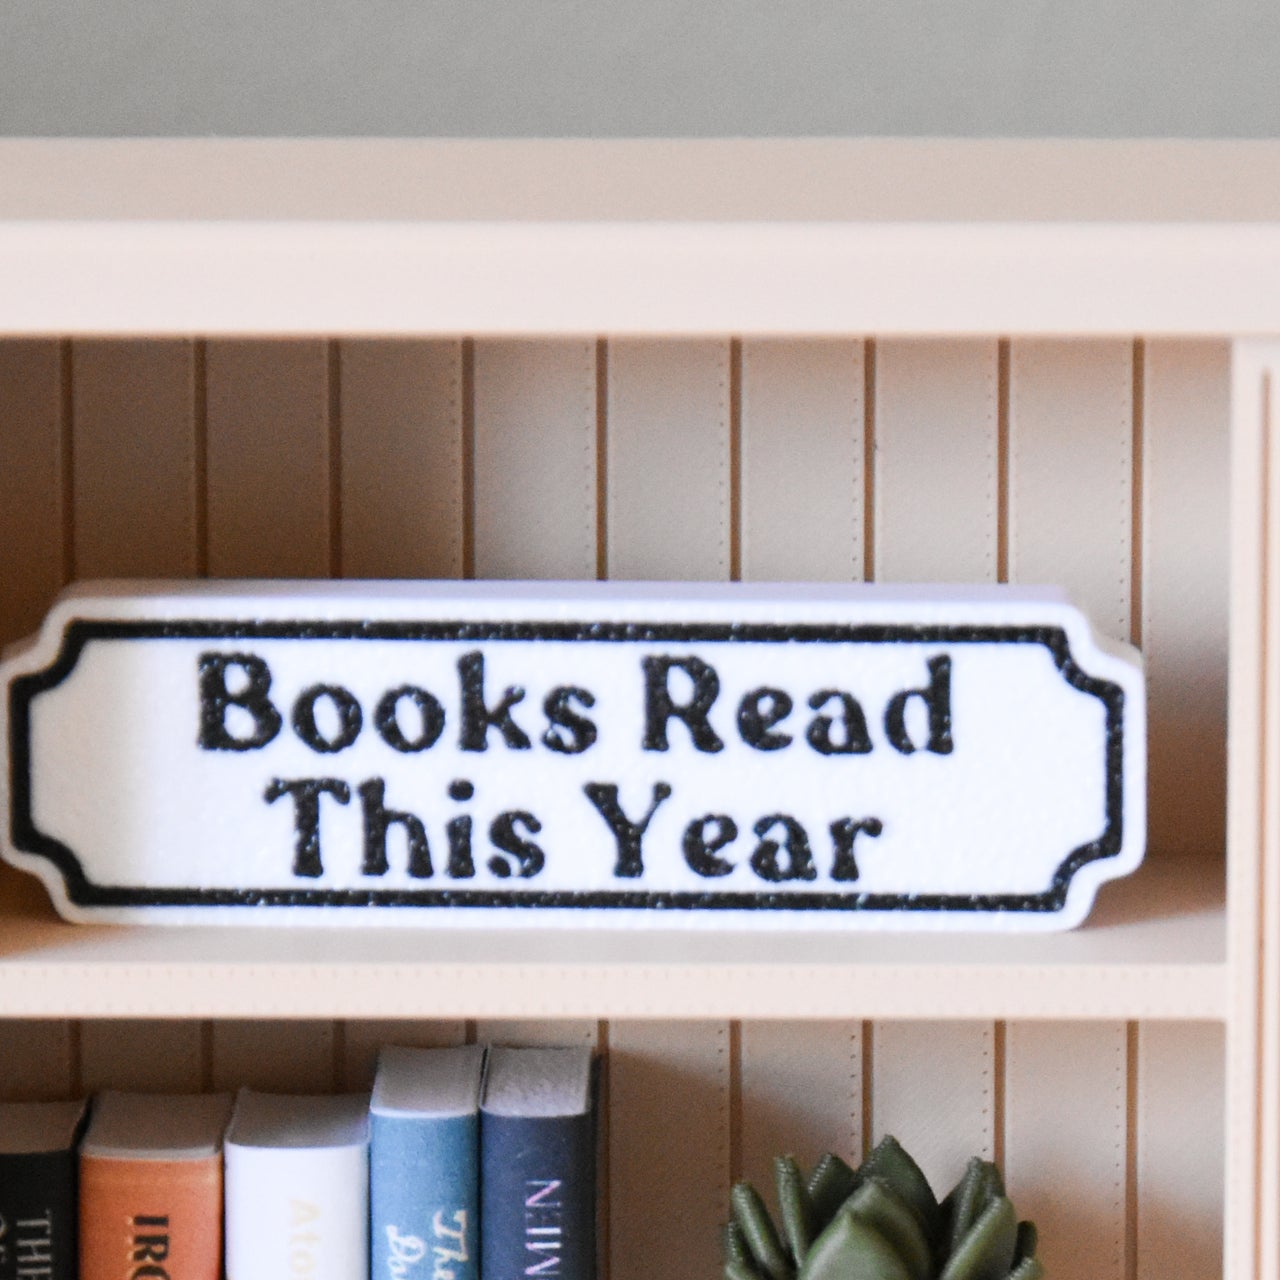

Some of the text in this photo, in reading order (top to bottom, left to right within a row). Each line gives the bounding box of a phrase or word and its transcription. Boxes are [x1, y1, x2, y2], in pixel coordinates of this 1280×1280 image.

[196, 651, 954, 756] Books Read
[263, 777, 884, 882] This Year
